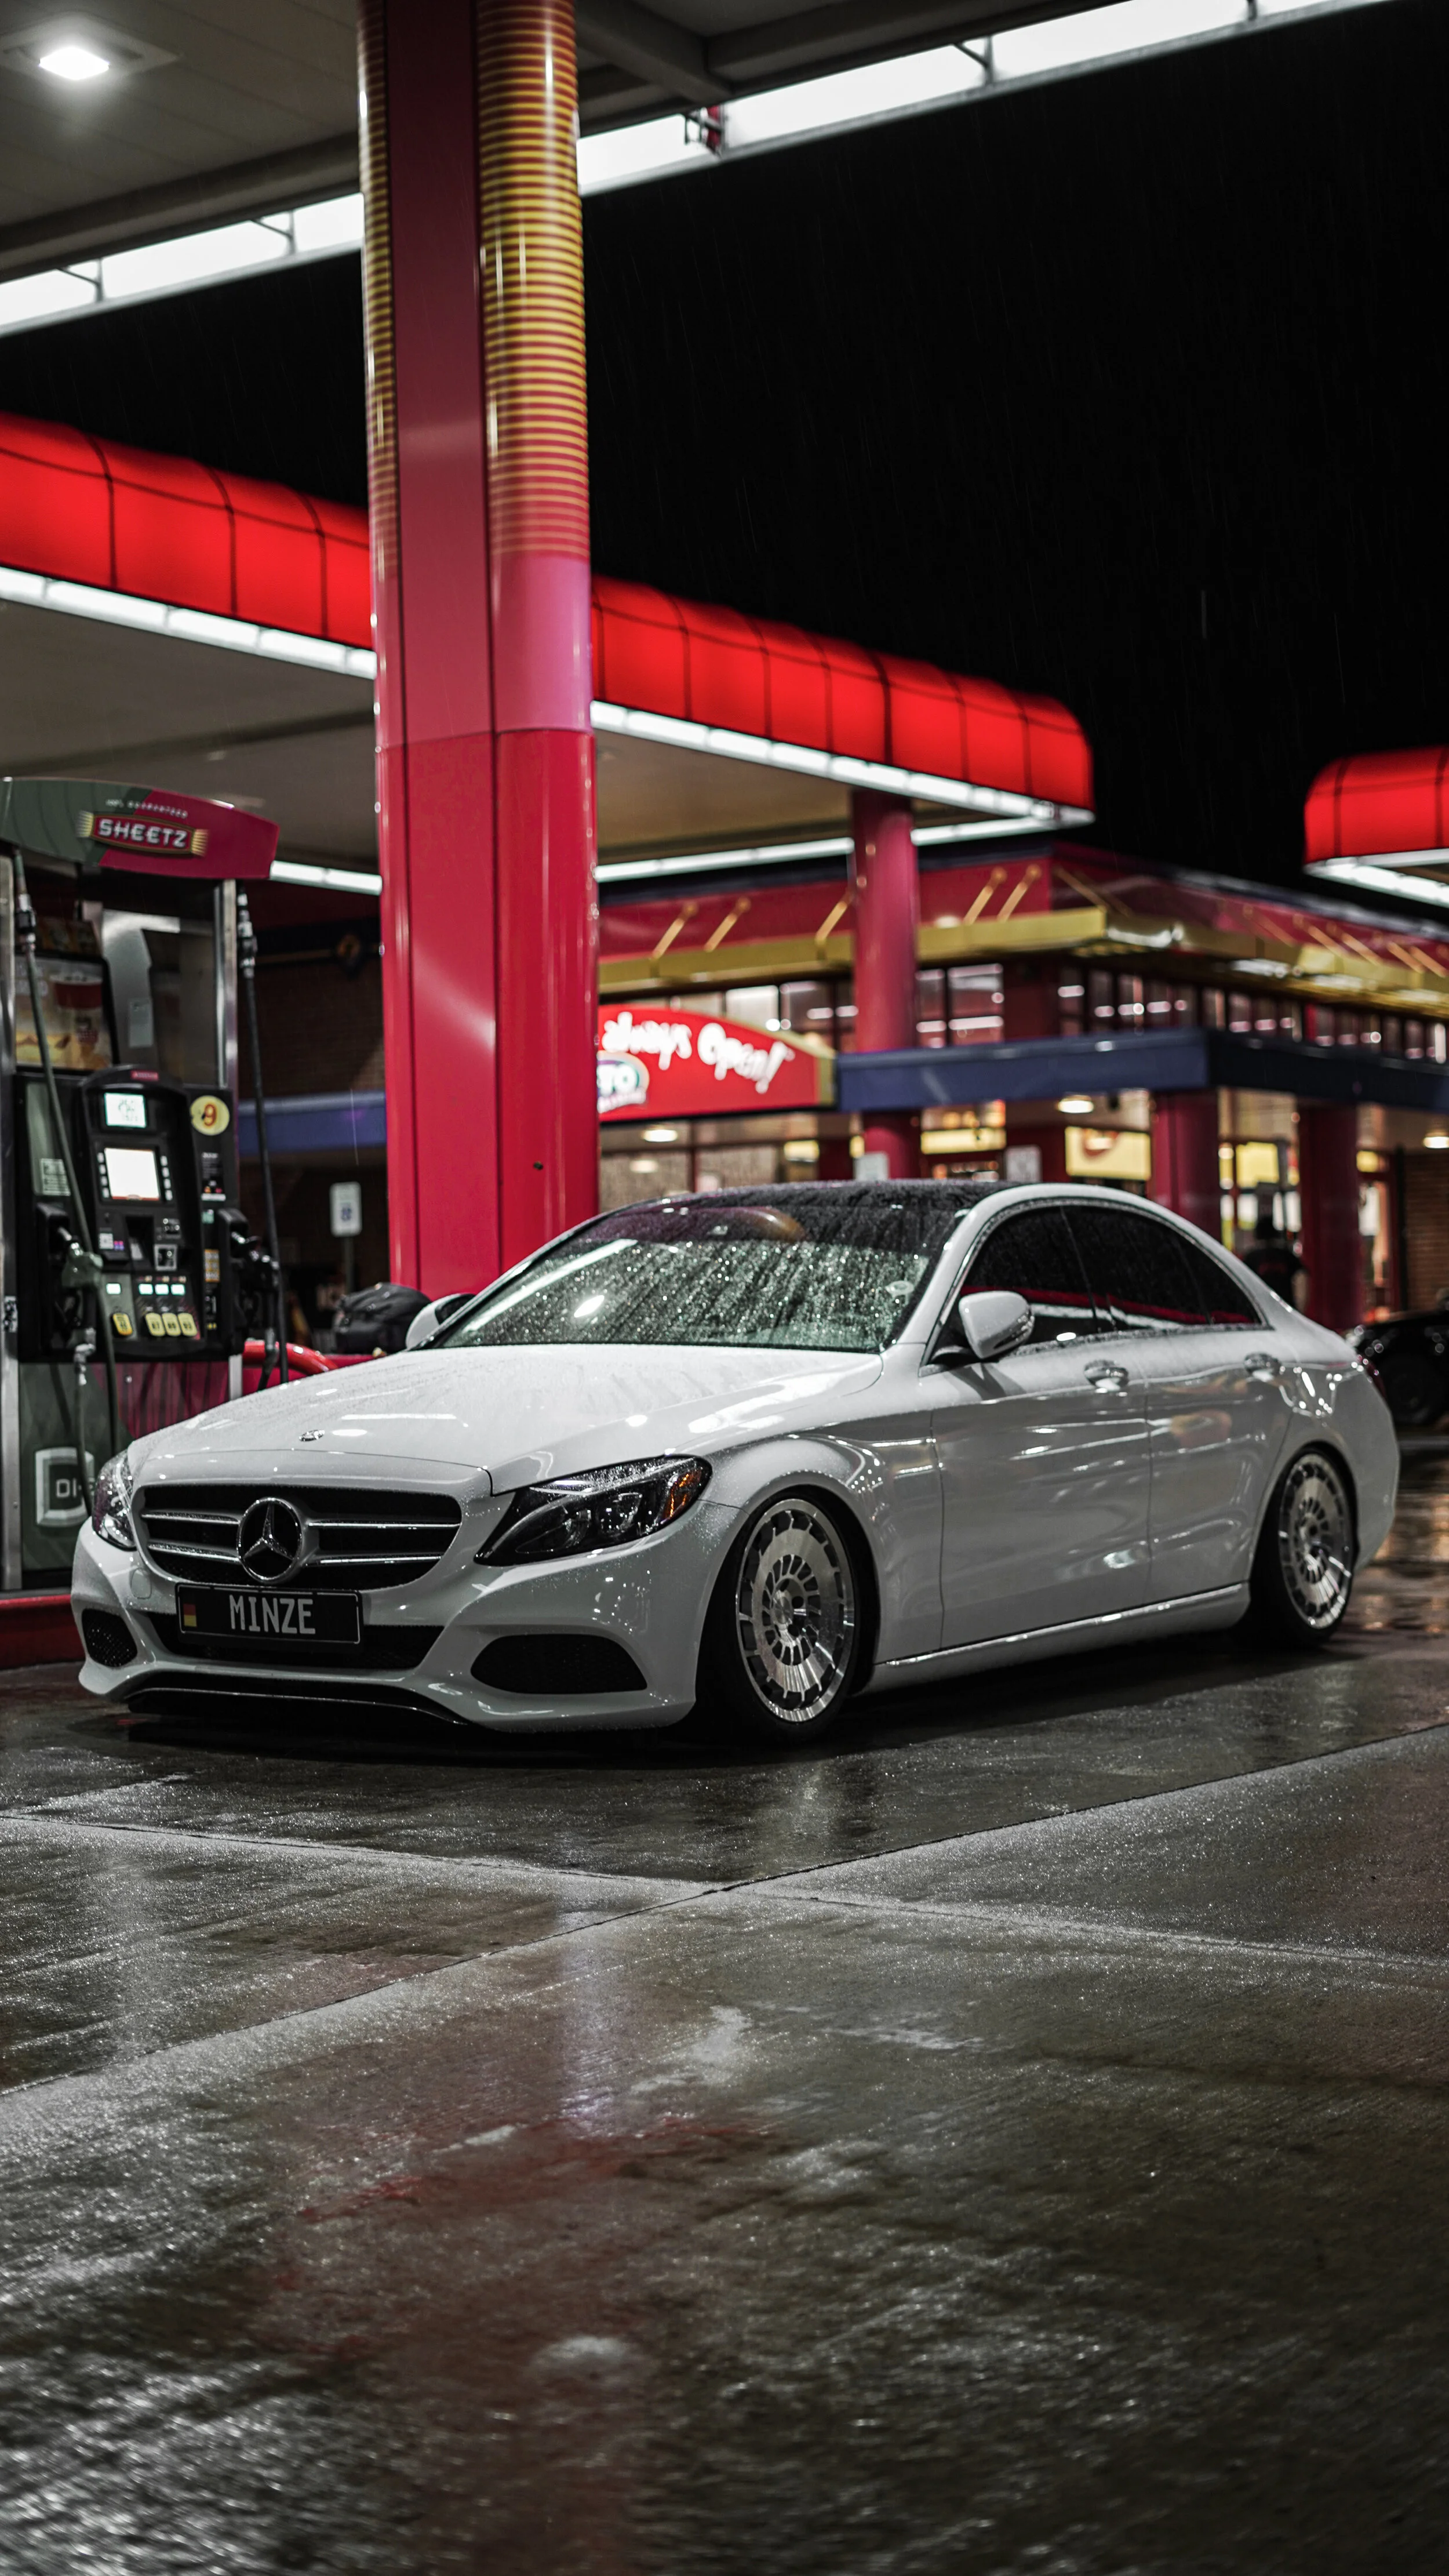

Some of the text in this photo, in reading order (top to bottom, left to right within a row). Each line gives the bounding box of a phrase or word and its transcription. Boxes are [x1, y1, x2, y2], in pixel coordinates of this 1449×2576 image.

[99, 819, 187, 848] SHEETZ
[205, 1104, 217, 1127] 9
[230, 1594, 316, 1634] MINZE
